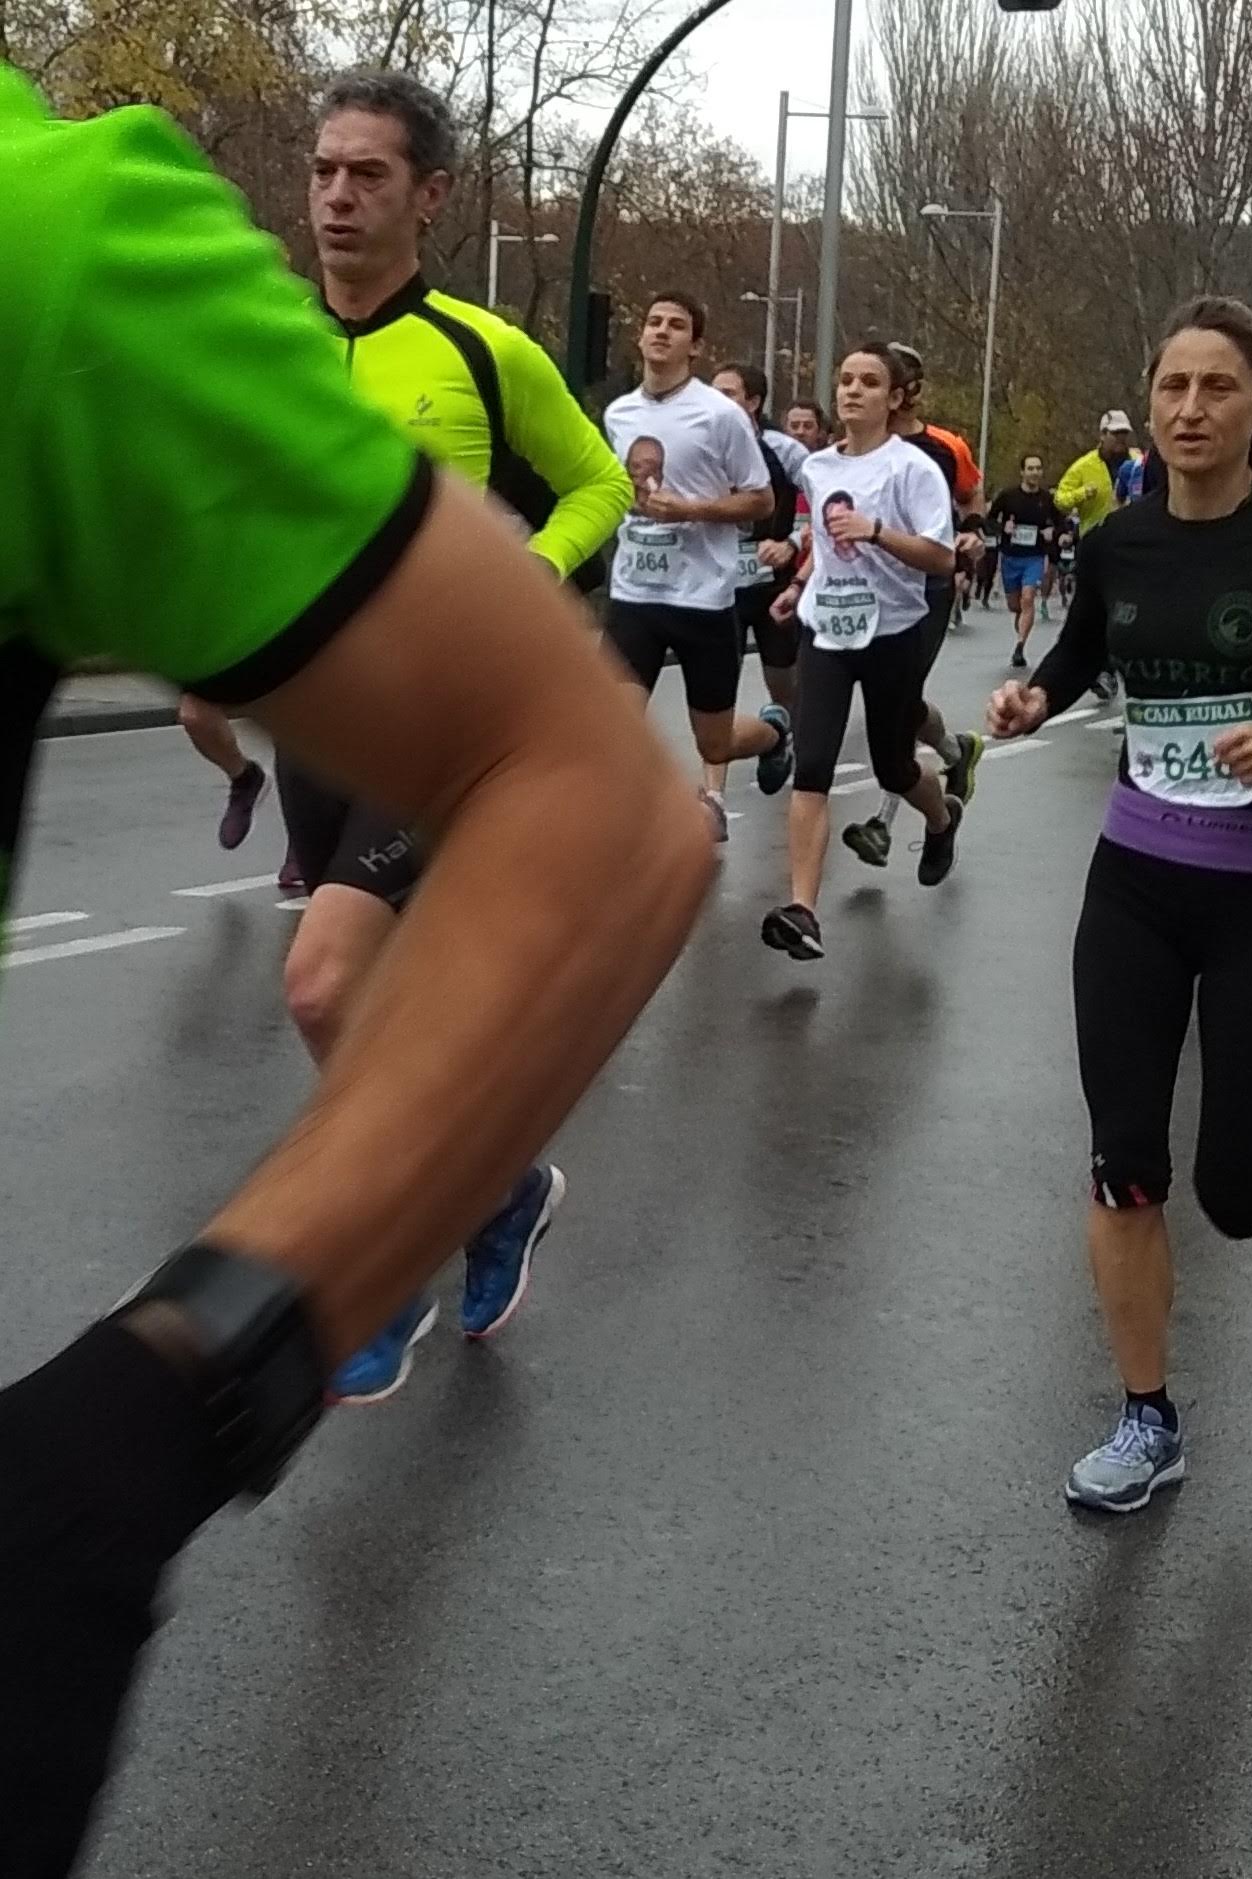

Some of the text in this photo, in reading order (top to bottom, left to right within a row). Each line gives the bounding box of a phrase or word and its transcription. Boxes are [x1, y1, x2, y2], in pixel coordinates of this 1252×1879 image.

[636, 550, 670, 573] 864
[831, 613, 869, 636] 834
[1143, 701, 1251, 724] CAJA RURAL
